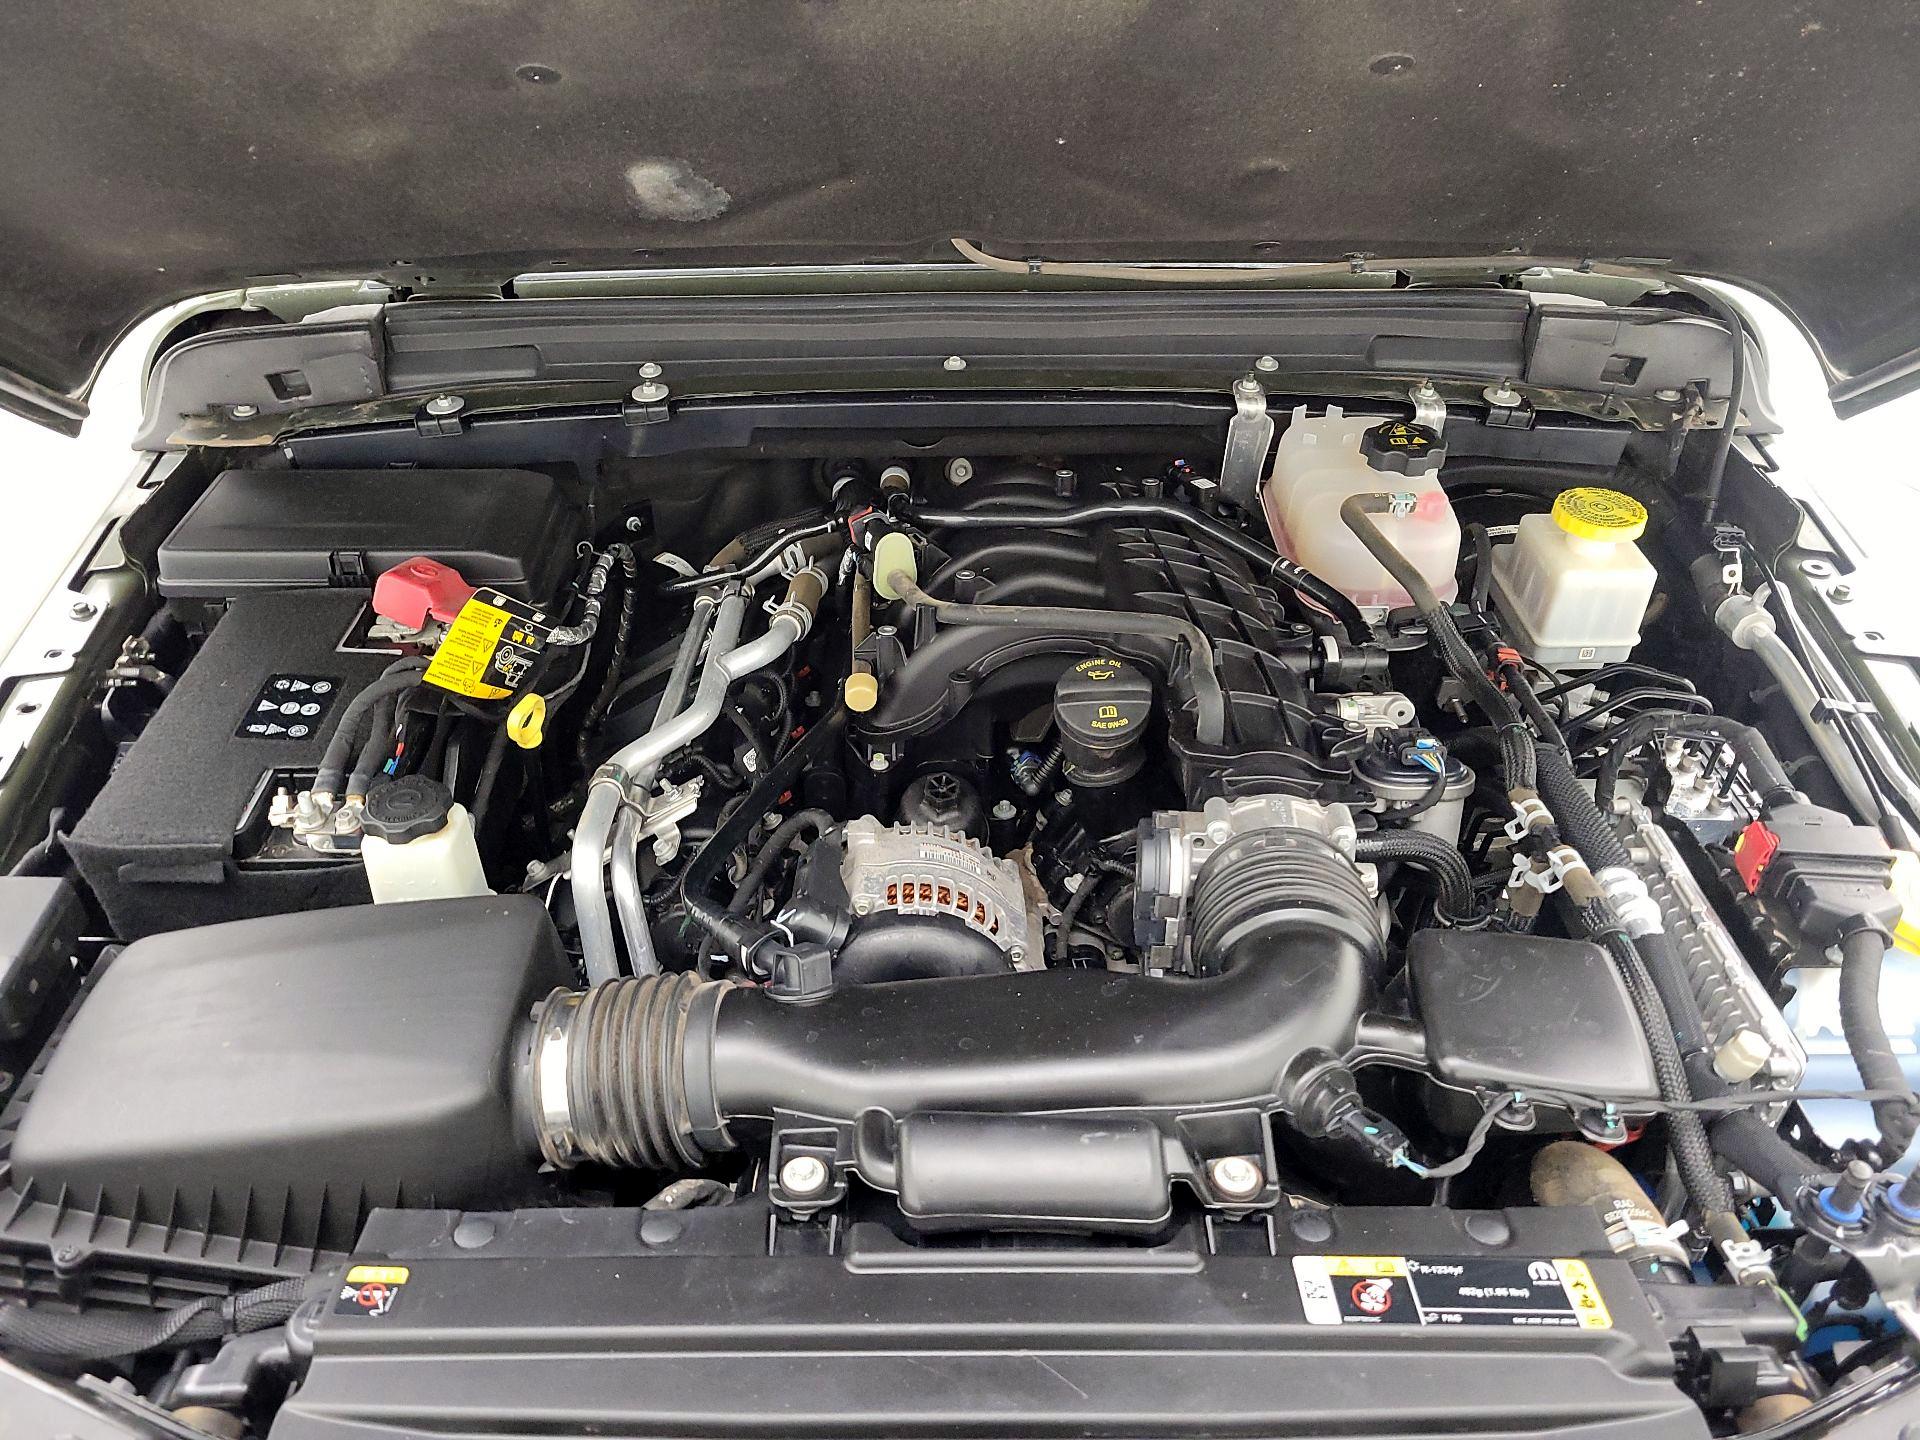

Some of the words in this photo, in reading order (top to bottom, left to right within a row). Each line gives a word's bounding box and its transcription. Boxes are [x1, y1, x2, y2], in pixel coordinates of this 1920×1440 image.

[1075, 659, 1106, 672] ENGINE
[1108, 659, 1122, 669] OIL
[1091, 720, 1107, 729] SAE
[1107, 718, 1129, 729] 0W-20
